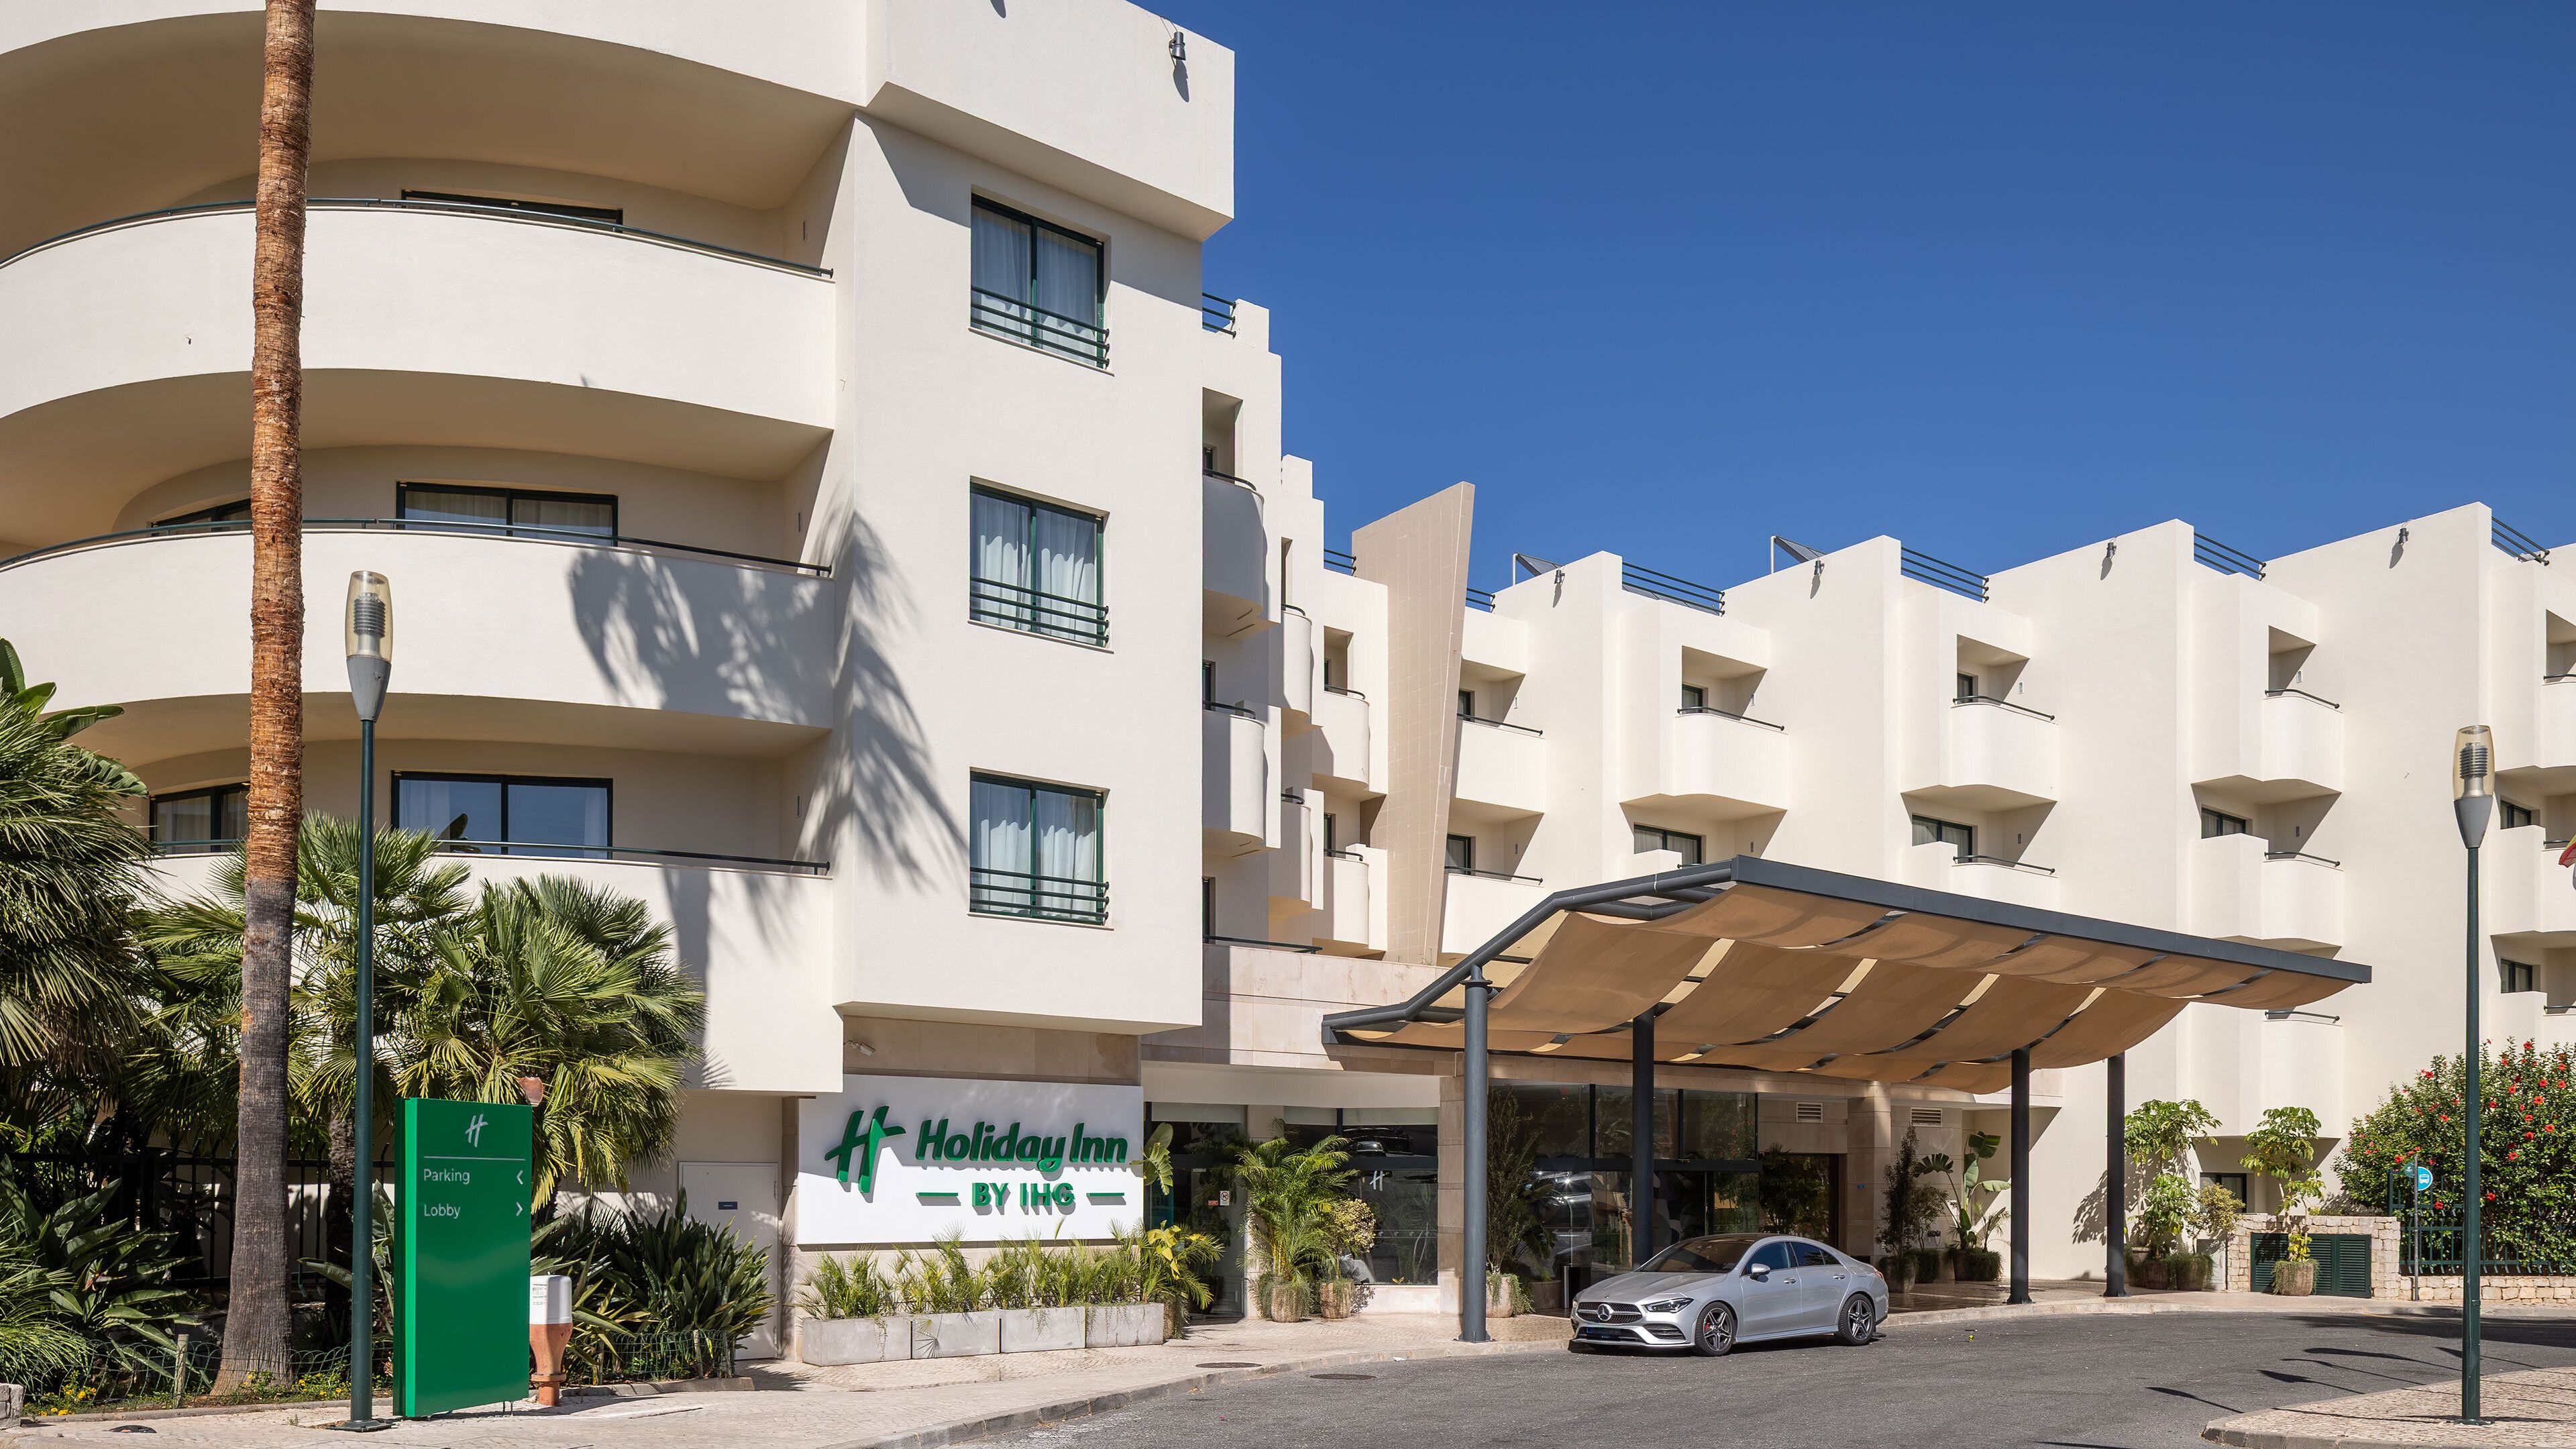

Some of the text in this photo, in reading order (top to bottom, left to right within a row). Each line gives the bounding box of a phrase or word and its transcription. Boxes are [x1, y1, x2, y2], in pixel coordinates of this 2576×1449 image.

[915, 1118, 1128, 1173] Holiday Inn
[423, 1168, 470, 1185] Parking
[971, 1182, 1076, 1207] BY IHG
[423, 1203, 461, 1220] Lobby
